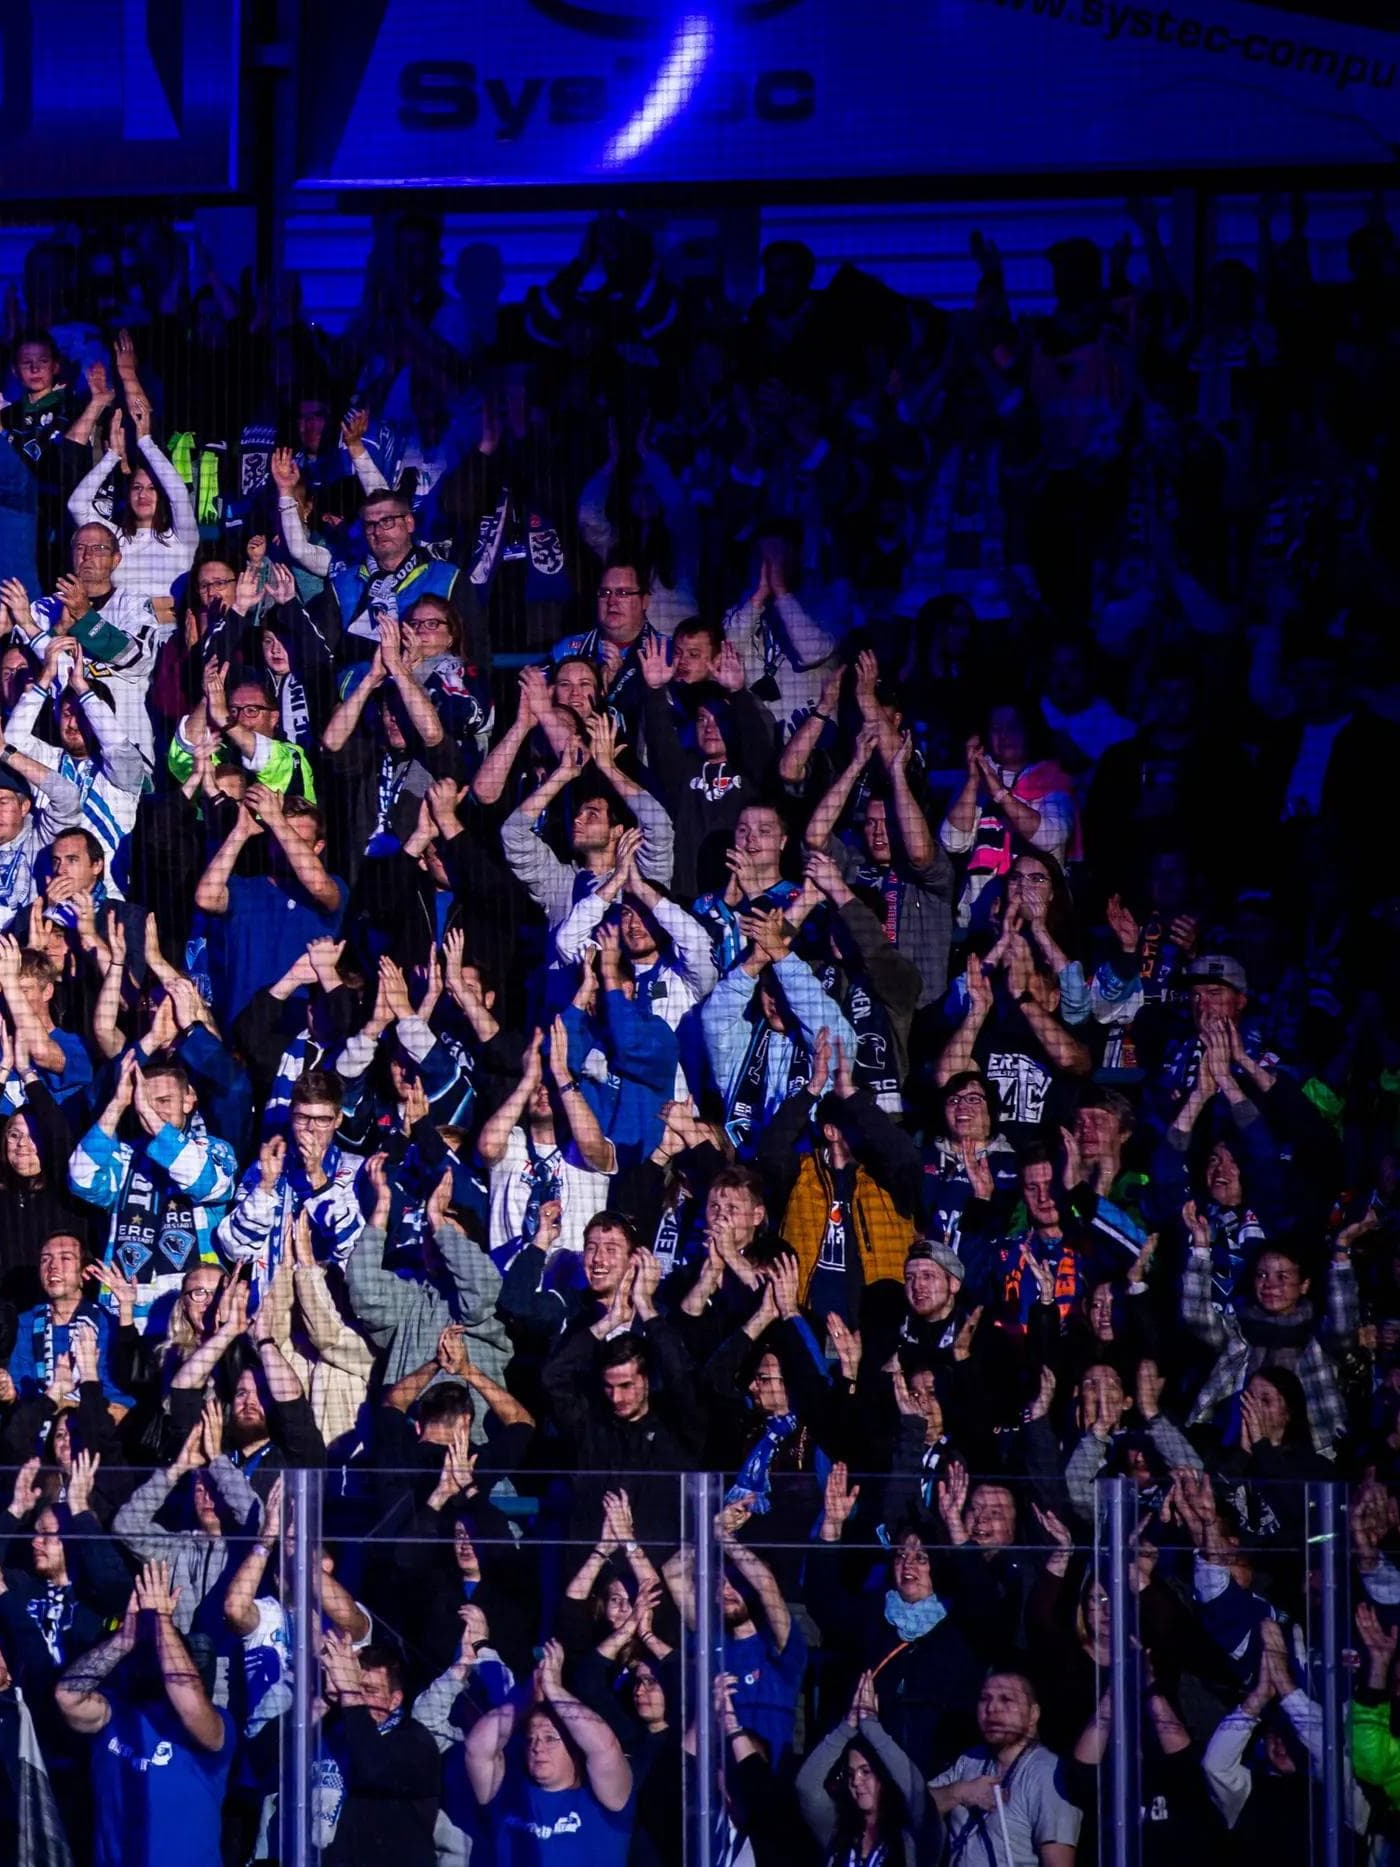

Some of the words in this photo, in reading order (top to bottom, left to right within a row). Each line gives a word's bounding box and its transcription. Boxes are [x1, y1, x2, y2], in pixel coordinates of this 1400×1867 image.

[396, 60, 818, 141] Sysc
[165, 1211, 192, 1223] RC
[119, 1225, 156, 1239] ERC
